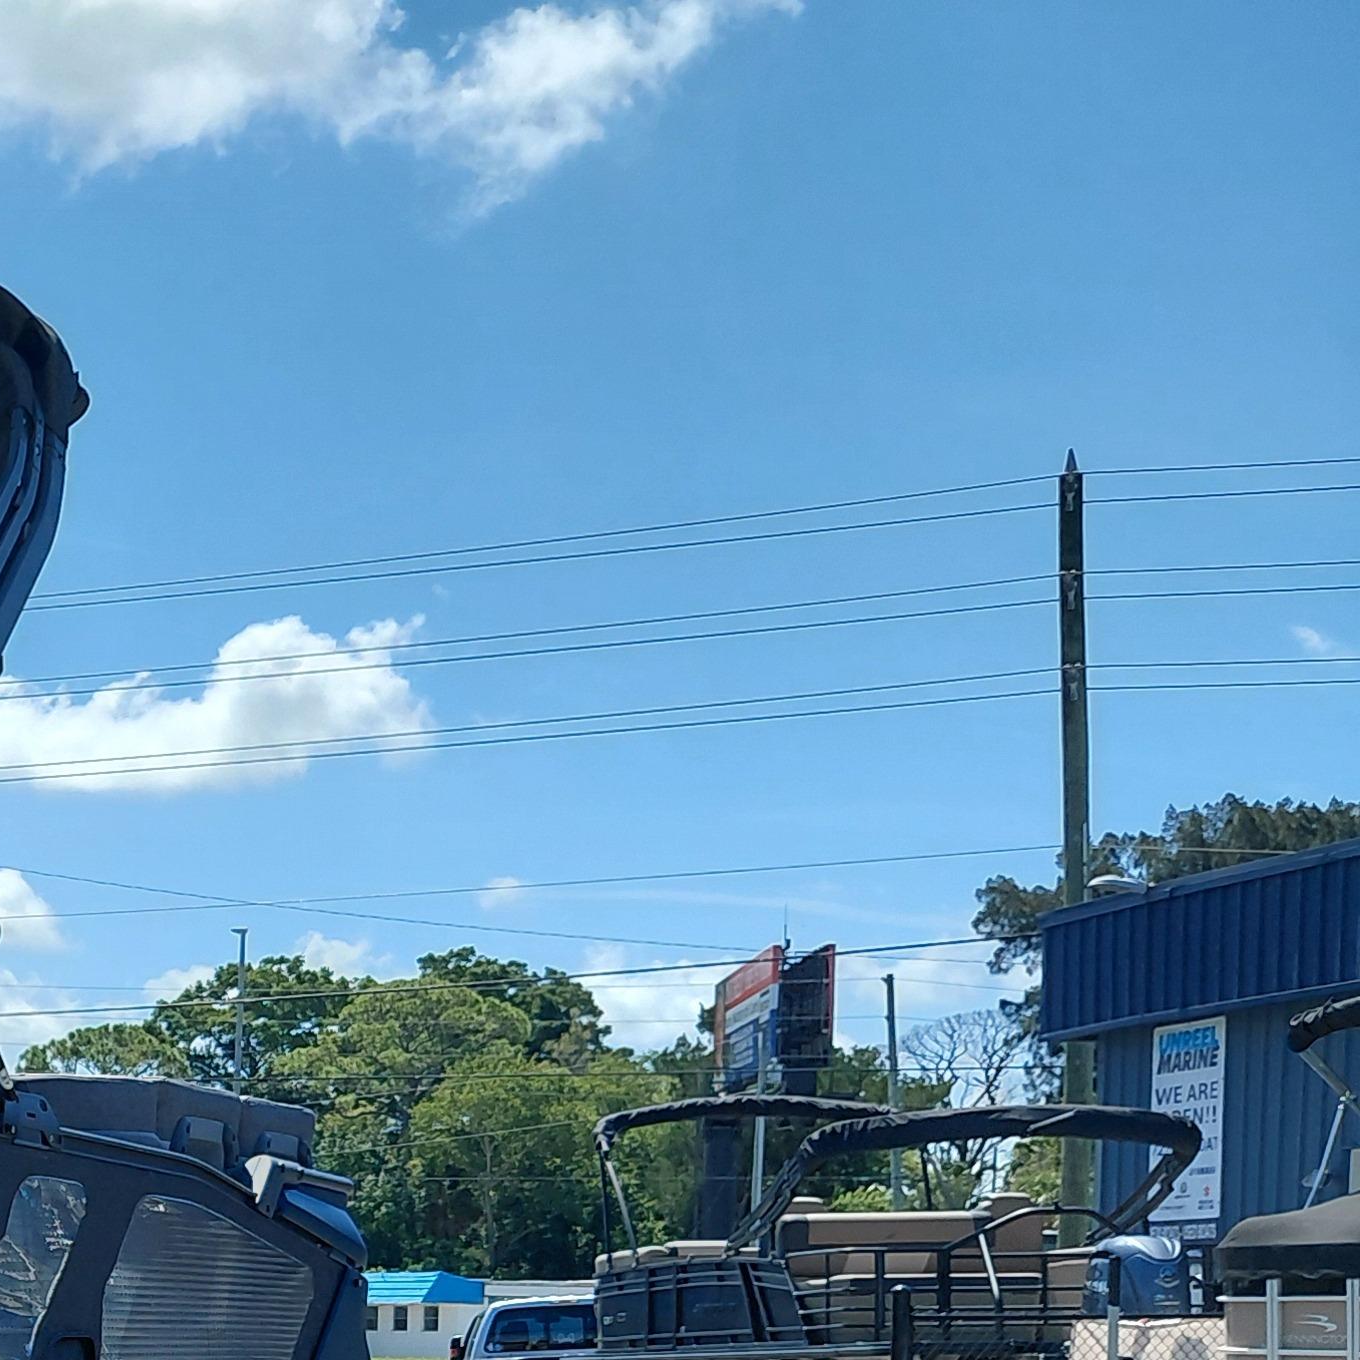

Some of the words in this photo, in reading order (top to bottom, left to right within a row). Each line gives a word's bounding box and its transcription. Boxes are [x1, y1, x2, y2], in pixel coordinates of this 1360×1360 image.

[1156, 1046, 1219, 1075] MARINE
[1155, 1085, 1182, 1106] WE
[1187, 1081, 1219, 1102] ARE
[1164, 1105, 1216, 1124] PEN!!
